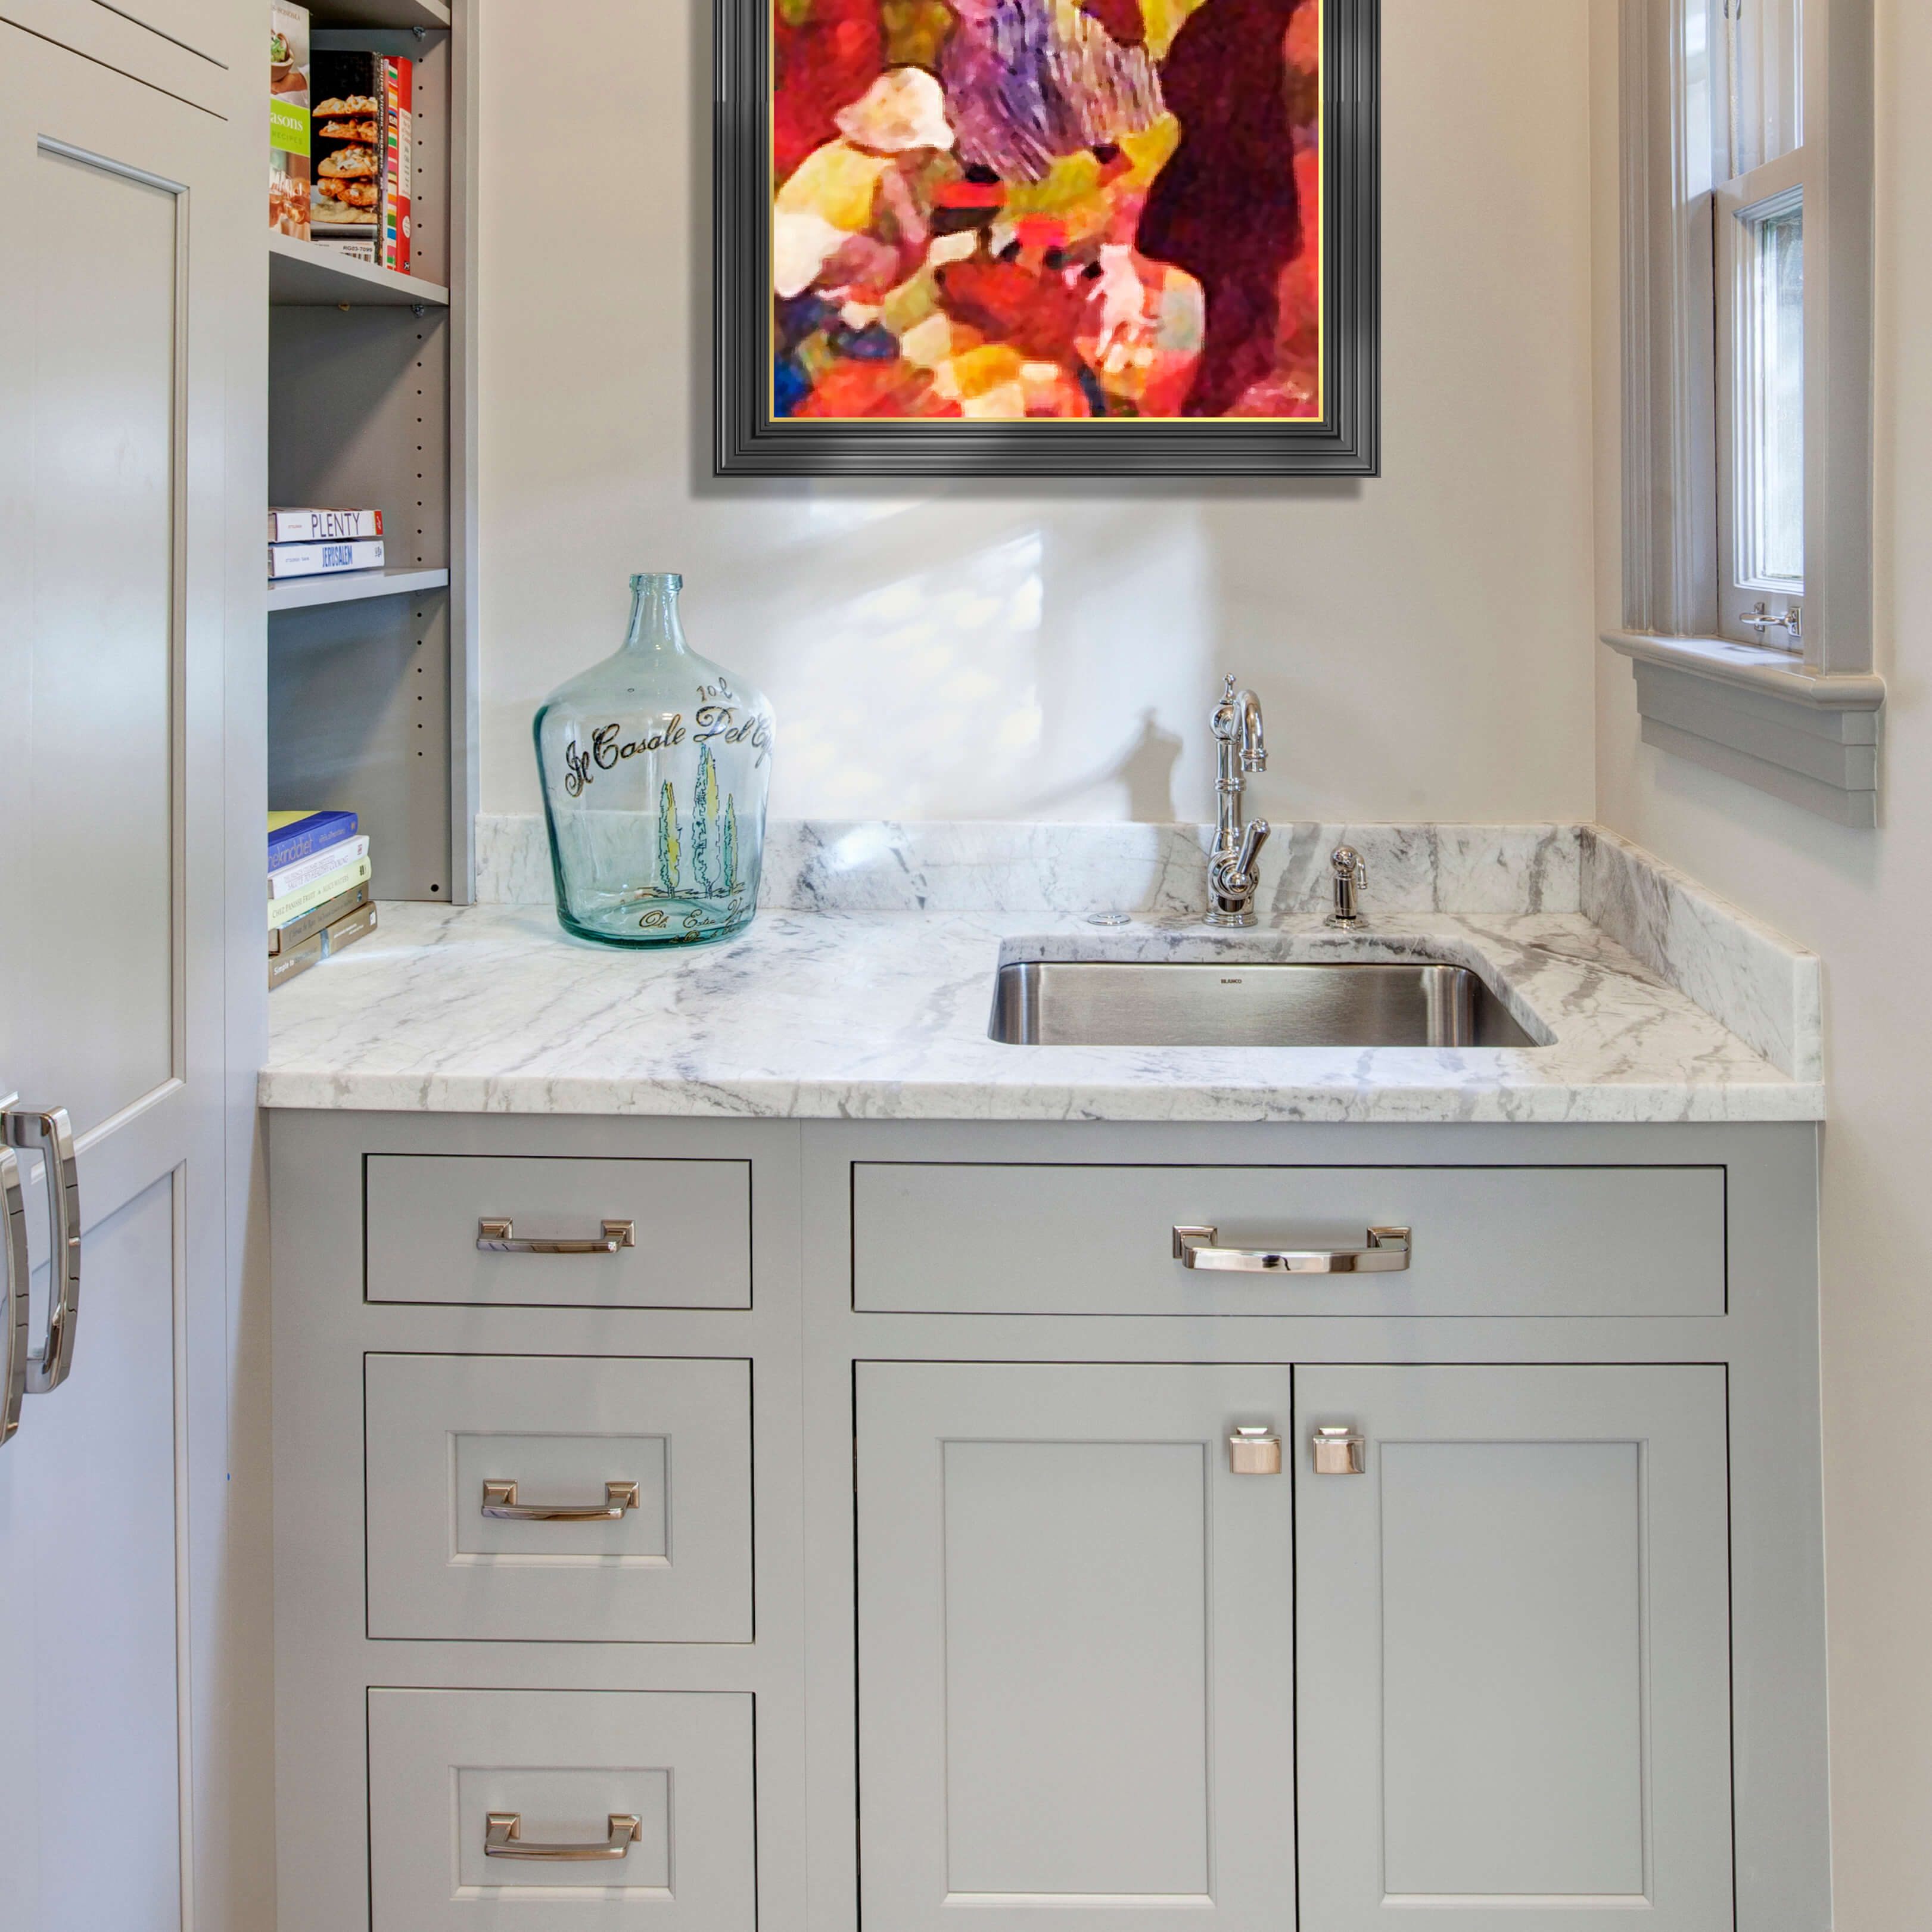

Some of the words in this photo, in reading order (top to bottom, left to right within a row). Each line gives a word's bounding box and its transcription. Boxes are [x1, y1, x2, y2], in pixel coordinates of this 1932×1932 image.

[311, 512, 360, 539] PLENTY
[322, 545, 353, 568] JERUSALEM
[592, 714, 686, 770] Casale
[693, 705, 756, 744] Del
